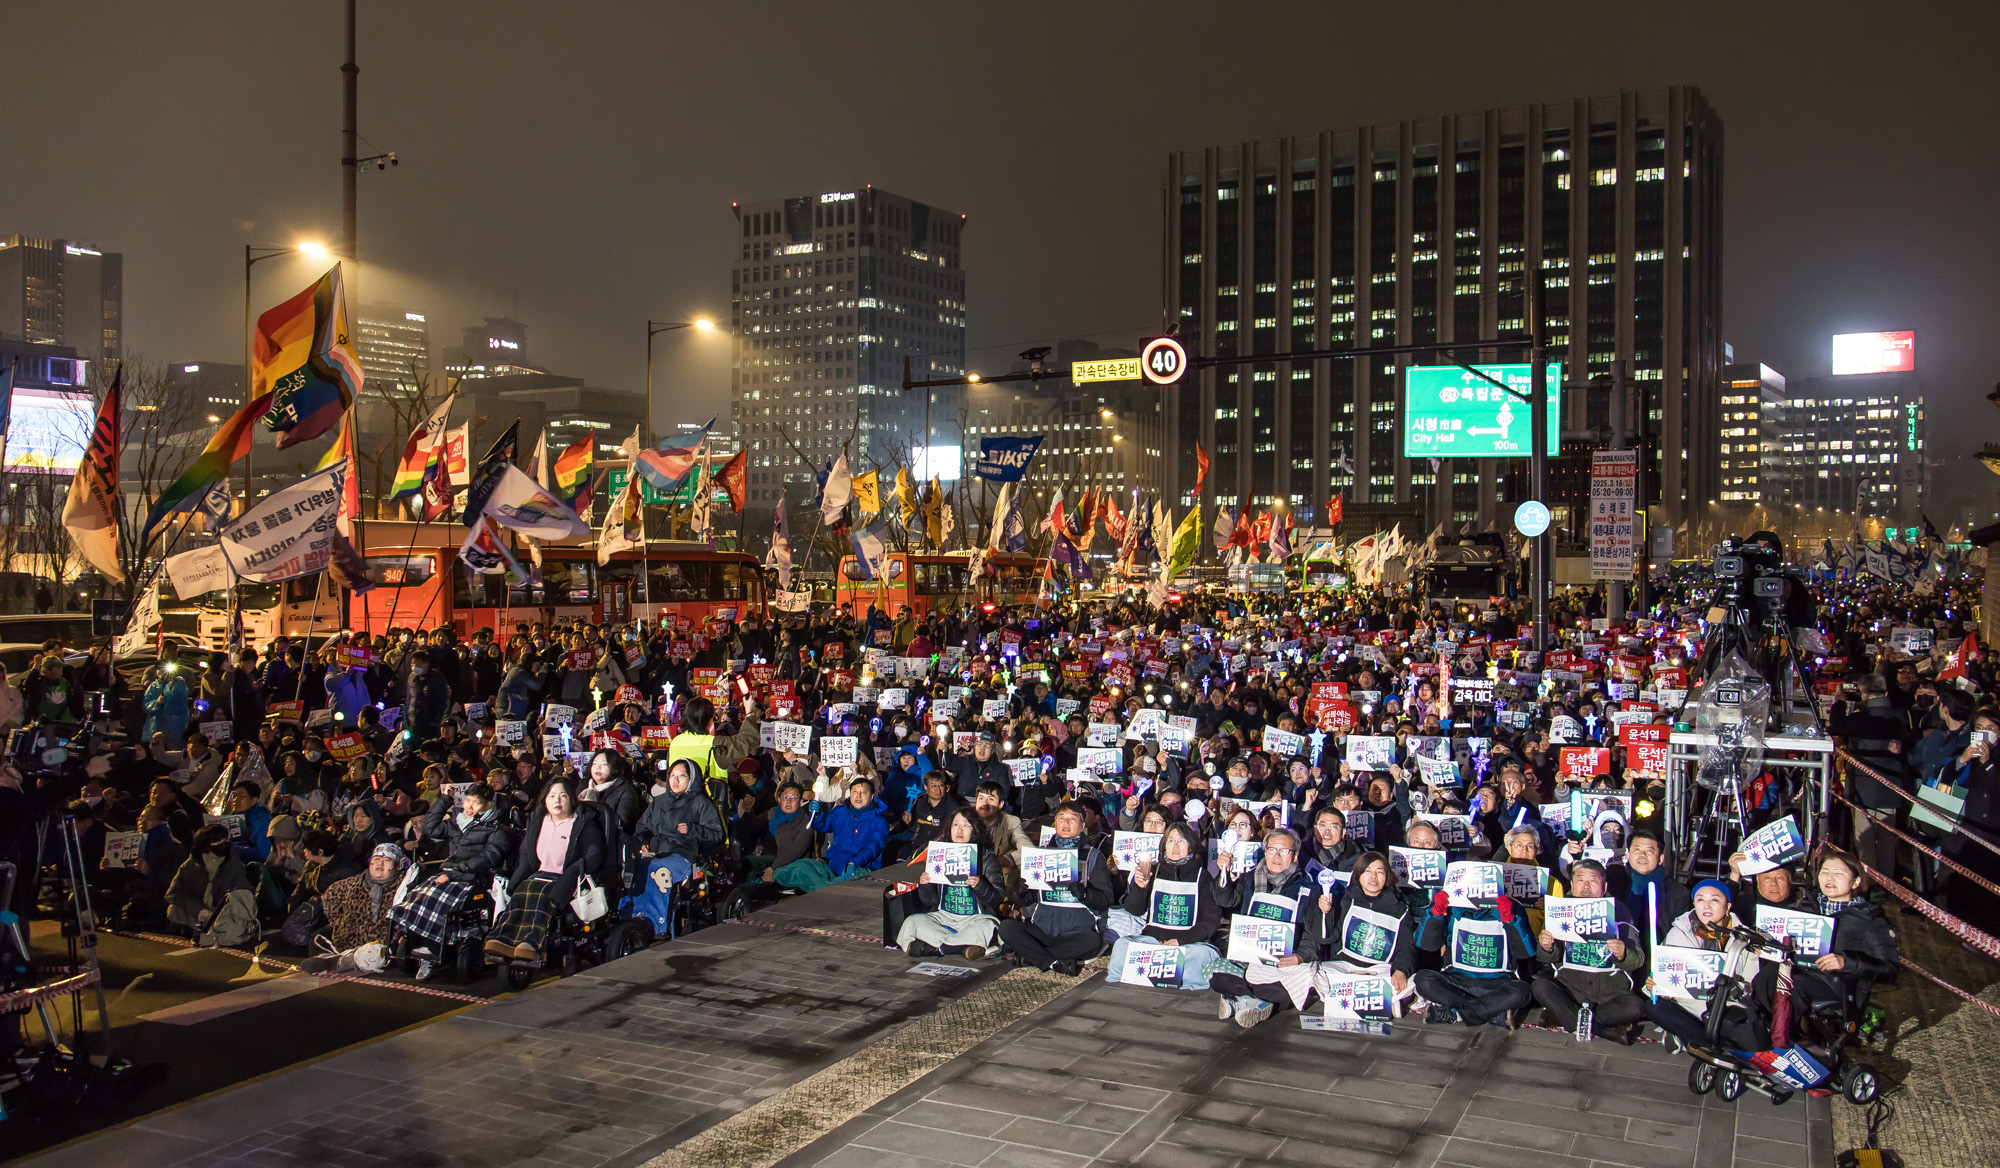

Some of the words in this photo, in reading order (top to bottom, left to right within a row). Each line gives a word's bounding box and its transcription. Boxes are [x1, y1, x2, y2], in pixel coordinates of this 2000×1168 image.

[1152, 350, 1176, 371] 40
[1076, 363, 1138, 378] 과속단속장비
[1461, 370, 1503, 384] 수역
[1508, 374, 1533, 383] Susae
[1461, 387, 1504, 401] 독립문
[1412, 418, 1437, 431] 시청
[1412, 434, 1432, 444] City
[1436, 434, 1454, 442] Hall
[1494, 441, 1518, 450] 100m
[1594, 466, 1634, 475] 교통통제안내
[1592, 488, 1633, 496] 05:20~09:00
[1593, 525, 1614, 536] 세종대로
[1616, 525, 1631, 536] 사거리
[1593, 547, 1630, 558] 광화문삼거리
[501, 618, 527, 626] Believe
[529, 616, 534, 624] it
[559, 615, 571, 624] 국어
[343, 648, 365, 657] 윤석열
[574, 652, 591, 660] 윤석열
[1620, 660, 1637, 668] 윤석열
[771, 684, 789, 692] 윤석열
[1319, 685, 1339, 693] 윤석열
[774, 699, 794, 708] 윤석열
[558, 707, 574, 715] 해체
[1324, 710, 1351, 719] 새봄에는
[1323, 718, 1351, 727] 새나라를
[1630, 713, 1648, 724] 즉각
[646, 729, 668, 738] 윤석열
[777, 727, 806, 739] 윤석열은
[1102, 725, 1117, 734] 즉각
[1163, 728, 1184, 740] 해체
[1563, 729, 1582, 738] 파면
[1628, 729, 1660, 740] 윤석열
[331, 737, 354, 749] 윤석열
[1102, 733, 1117, 742] 파면
[822, 739, 853, 751] 윤석열은
[1162, 740, 1183, 752] 하라
[1278, 742, 1297, 755] 파면
[1366, 738, 1390, 751] 해체
[1094, 753, 1116, 764] 해체
[1366, 751, 1390, 764] 하라
[1566, 753, 1598, 765] 윤석열
[1637, 747, 1667, 760] 윤석열
[1019, 760, 1035, 770] 즉각
[1094, 763, 1117, 775] 하라
[1432, 762, 1454, 774] 즉각
[1571, 765, 1593, 776] 파면
[1643, 760, 1666, 771] 파면
[1019, 770, 1036, 780] 파면
[1433, 774, 1455, 785] 파면
[1346, 812, 1368, 827] 해체
[1441, 818, 1465, 831] 즉각
[1346, 826, 1368, 839] 하라
[1759, 820, 1787, 839] 즉각
[1134, 834, 1160, 850] 해체
[1441, 831, 1465, 844] 파면
[1762, 836, 1795, 858] 파면
[945, 846, 971, 861] 즉각
[1044, 852, 1071, 867] 즉각
[1024, 861, 1043, 869] 윤석열
[1391, 861, 1410, 869] 윤석열
[1412, 853, 1440, 868] 즉각
[945, 861, 971, 877] 파면
[1044, 866, 1072, 883] 파면
[1412, 867, 1440, 882] 파면
[947, 886, 969, 896] 윤석열
[1467, 881, 1499, 898] 파면
[1512, 885, 1542, 898] 파면
[945, 895, 973, 905] 즉각파면
[1162, 895, 1186, 905] 윤석열
[945, 903, 973, 914] 단식농성
[1158, 904, 1189, 915] 즉각파면
[1258, 904, 1283, 918] 윤석열
[1548, 905, 1573, 913] 내란동조
[1574, 901, 1608, 919] 해체
[1157, 913, 1189, 925] 단식농성
[1548, 911, 1573, 919] 국민의힘
[1760, 916, 1786, 925] 내란수괴
[1257, 925, 1288, 940] 즉각
[1573, 918, 1608, 936] 하라
[1760, 924, 1785, 934] 윤석열
[1786, 917, 1824, 937] 즉각
[1467, 934, 1494, 947] 윤석열
[1257, 940, 1286, 956] 파면
[1462, 945, 1498, 957] 즉각파면
[1129, 956, 1151, 964] 윤석열
[1152, 949, 1179, 964] 즉각
[1461, 954, 1497, 968] 단식농성
[1571, 952, 1607, 967] 단식농성
[1149, 964, 1177, 979] 파면
[1658, 962, 1684, 972] 윤석열
[1330, 981, 1353, 991] 내란수괴
[1685, 972, 1721, 990] 파면
[1329, 988, 1353, 997] 윤석열
[1354, 979, 1385, 996] 즉각
[1353, 996, 1385, 1011] 파면
